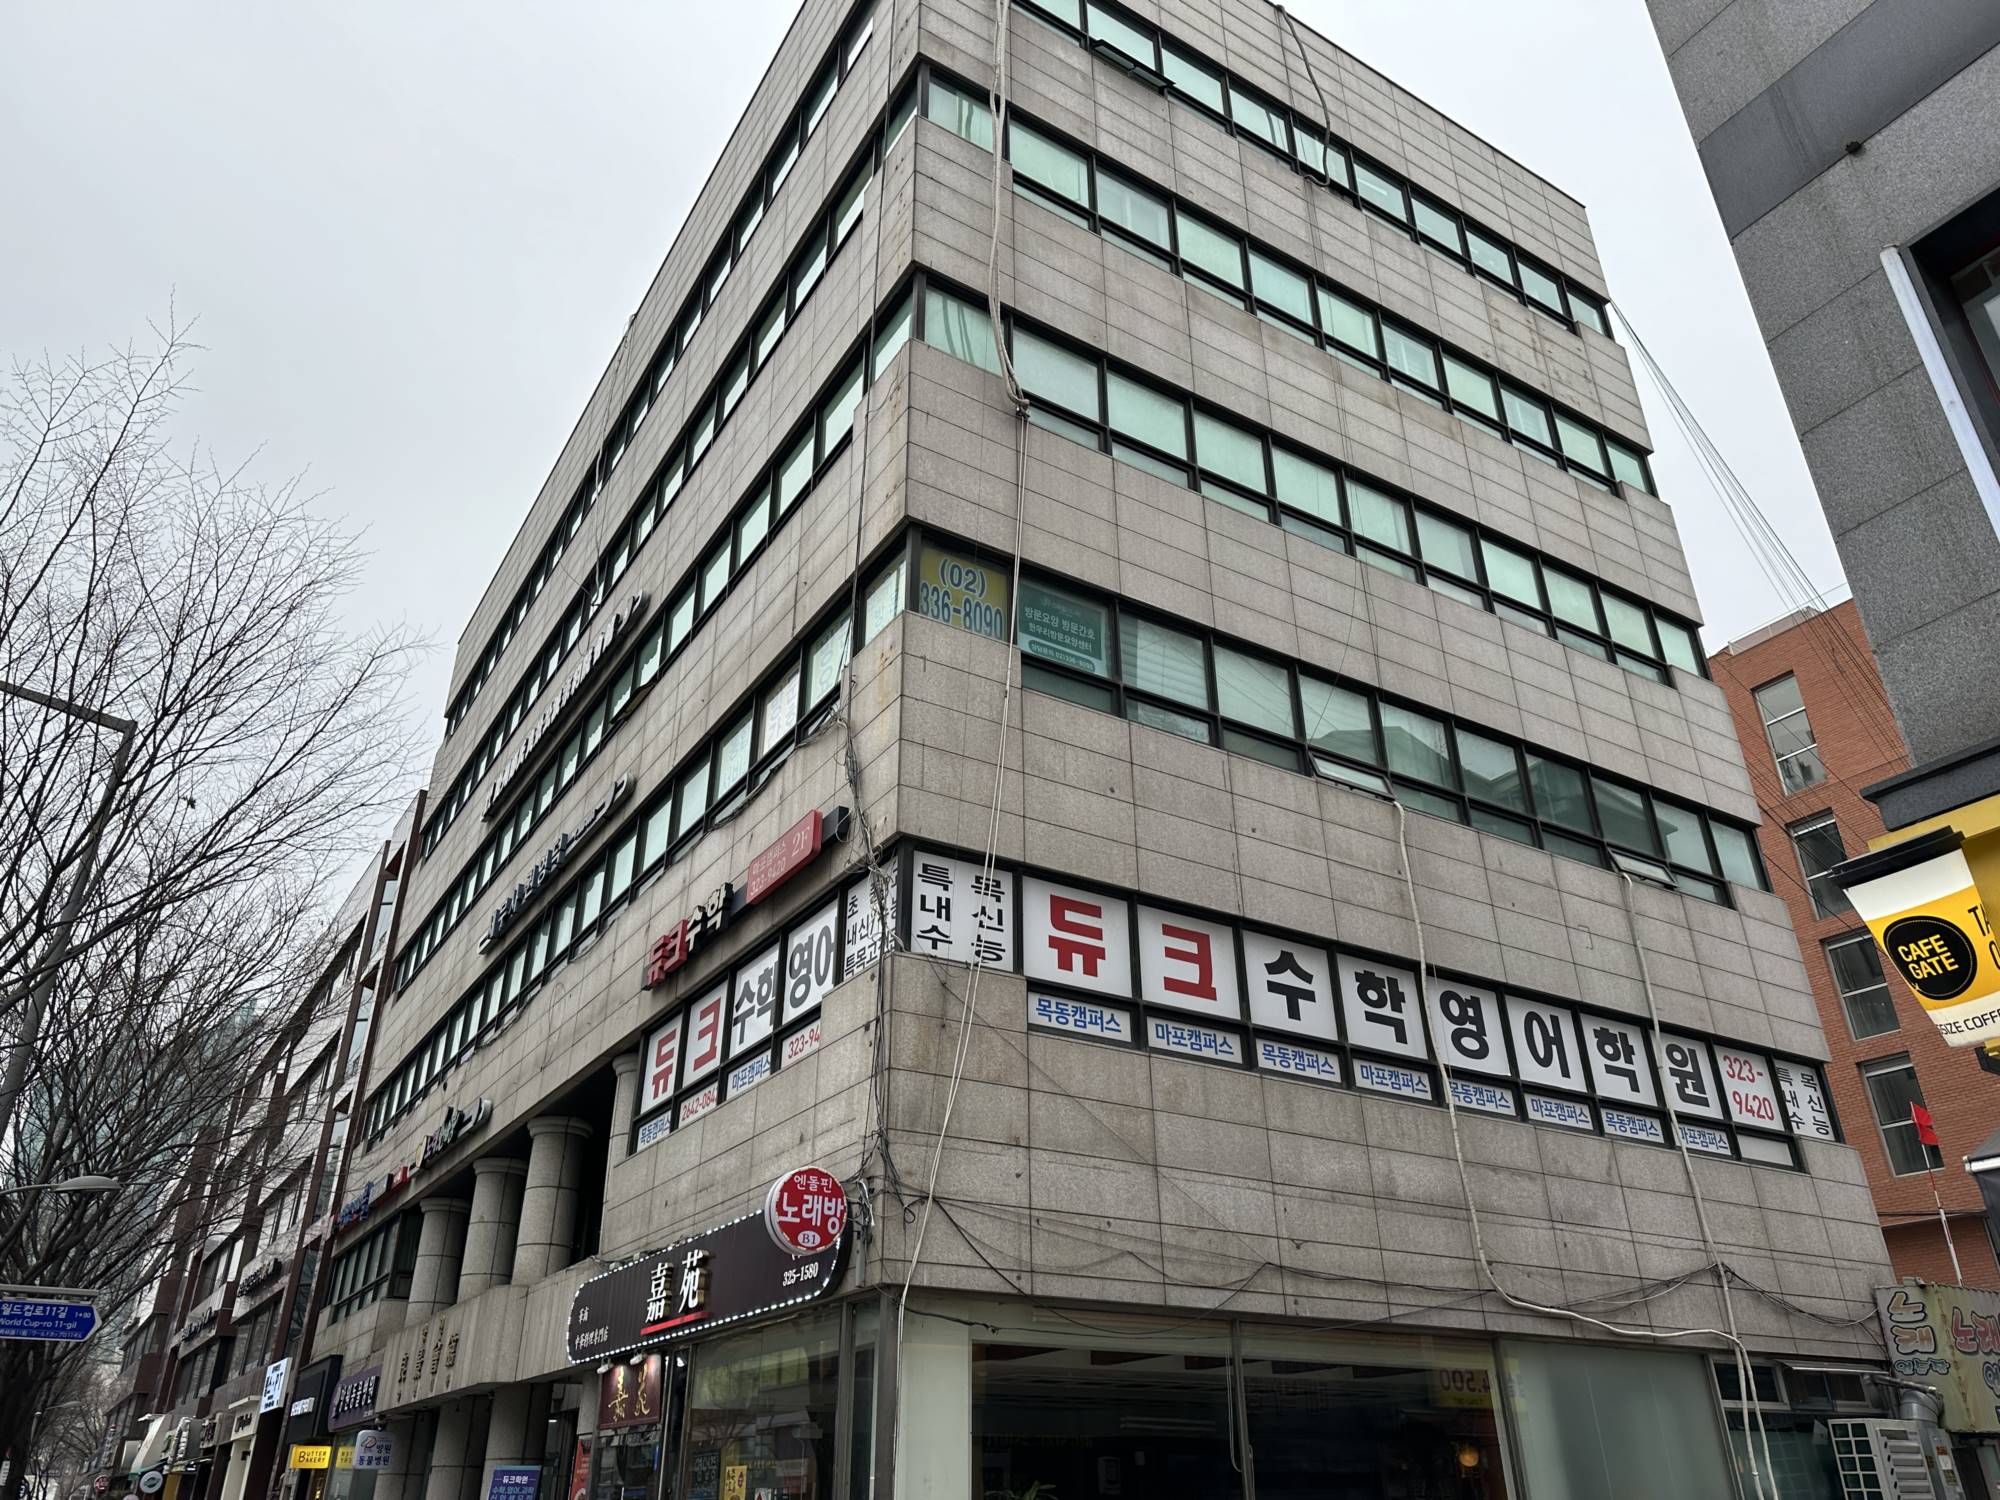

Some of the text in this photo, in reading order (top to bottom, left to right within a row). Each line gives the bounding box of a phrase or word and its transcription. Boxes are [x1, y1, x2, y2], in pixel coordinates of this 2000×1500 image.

[939, 558, 987, 598] (02)
[919, 582, 1005, 640] 336-8090
[1024, 607, 1059, 628] 방문요양
[791, 826, 811, 858] 2F
[751, 857, 786, 897] 323-9420
[1898, 933, 1949, 963] CAFE
[1908, 952, 1960, 980] GATE
[1036, 999, 1122, 1034] 목동캠퍼스
[1155, 1022, 1234, 1057] 마포캠퍼스
[1262, 1043, 1335, 1076] 목동캠퍼스
[1360, 1064, 1428, 1094] 마포캠퍼스
[1450, 1081, 1511, 1110] 목동캠퍼스
[1531, 1097, 1591, 1131] 마포캠퍼스
[1605, 1111, 1660, 1138] 목동캠퍼스
[1723, 1054, 1764, 1084] 323-
[682, 1088, 718, 1121] 2642-084
[732, 1057, 771, 1091] 마포캠퍼스
[1732, 1090, 1775, 1121] 9420
[794, 1174, 833, 1193] 엔돌핀
[778, 1192, 844, 1234] 노래방
[802, 1233, 816, 1245] B1
[645, 1250, 704, 1323] 嘉苑
[783, 1262, 819, 1287] 325-1580
[1, 1303, 69, 1319] 월드컵로11길
[23, 1318, 53, 1331] Cup-ro
[55, 1320, 78, 1330] 11-gil
[1887, 1291, 1937, 1355] 노래
[298, 1451, 328, 1460] BUTTER
[358, 1456, 391, 1467] 동물병원
[502, 1475, 529, 1485] 듀크학원
